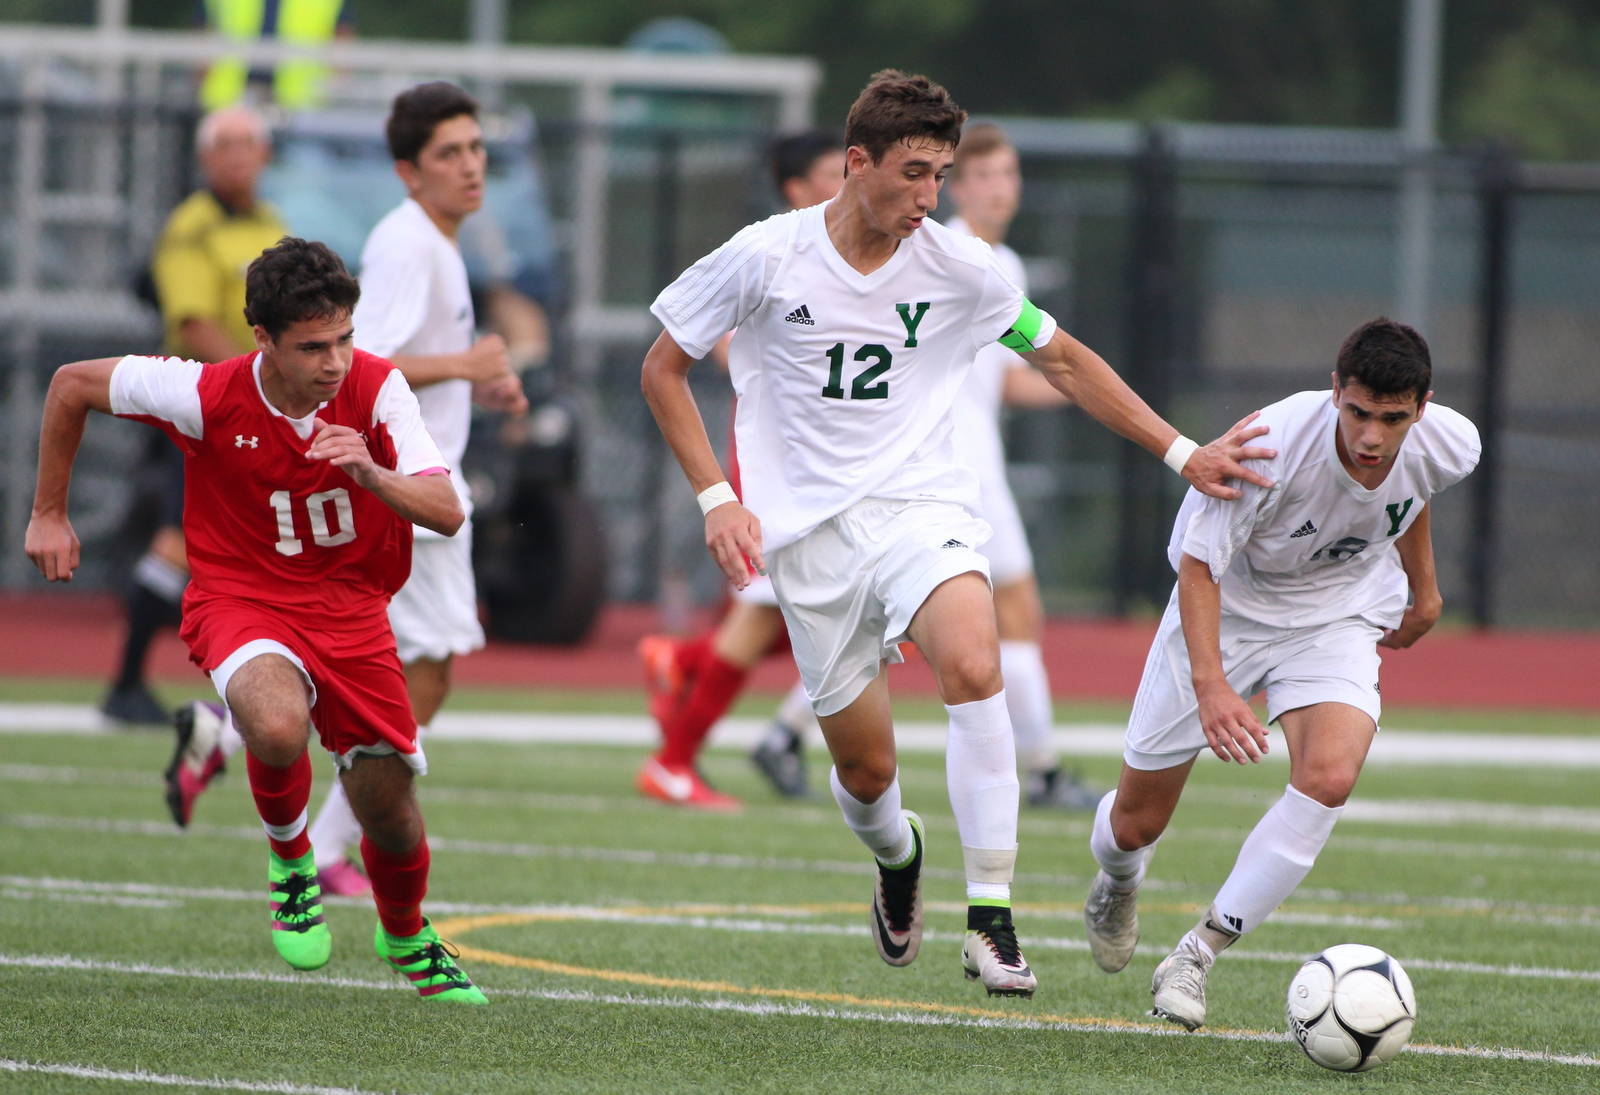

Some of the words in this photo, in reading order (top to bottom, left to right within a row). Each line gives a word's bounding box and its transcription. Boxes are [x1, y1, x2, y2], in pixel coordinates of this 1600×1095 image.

[785, 315, 815, 326] adidas
[895, 302, 931, 348] Y
[821, 342, 893, 400] 12
[269, 487, 357, 557] 10
[1385, 496, 1414, 537] Y
